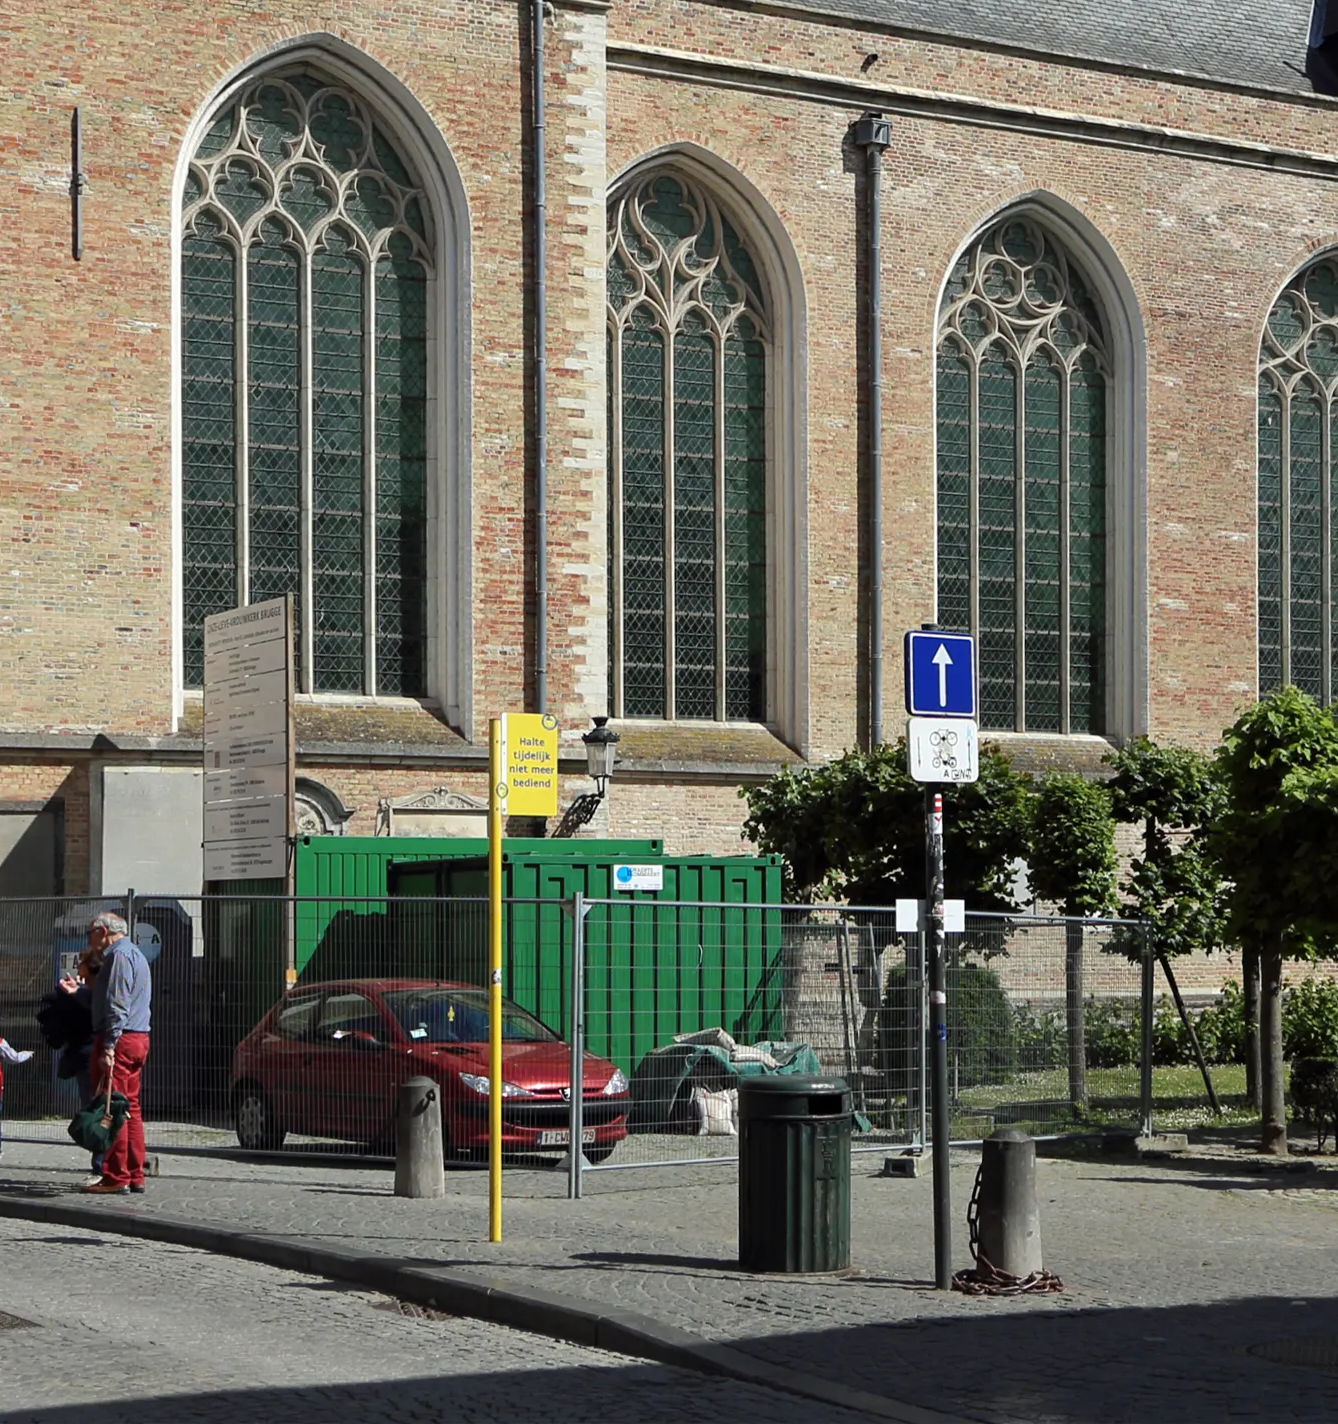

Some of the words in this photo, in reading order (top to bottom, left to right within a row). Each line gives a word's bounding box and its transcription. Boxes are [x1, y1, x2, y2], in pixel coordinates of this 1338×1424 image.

[260, 605, 282, 620] BRUGGE
[519, 737, 545, 747] Halte
[513, 750, 551, 763] tijdelijk
[509, 764, 528, 774] niet
[531, 766, 555, 775] meer
[513, 778, 551, 788] bediend
